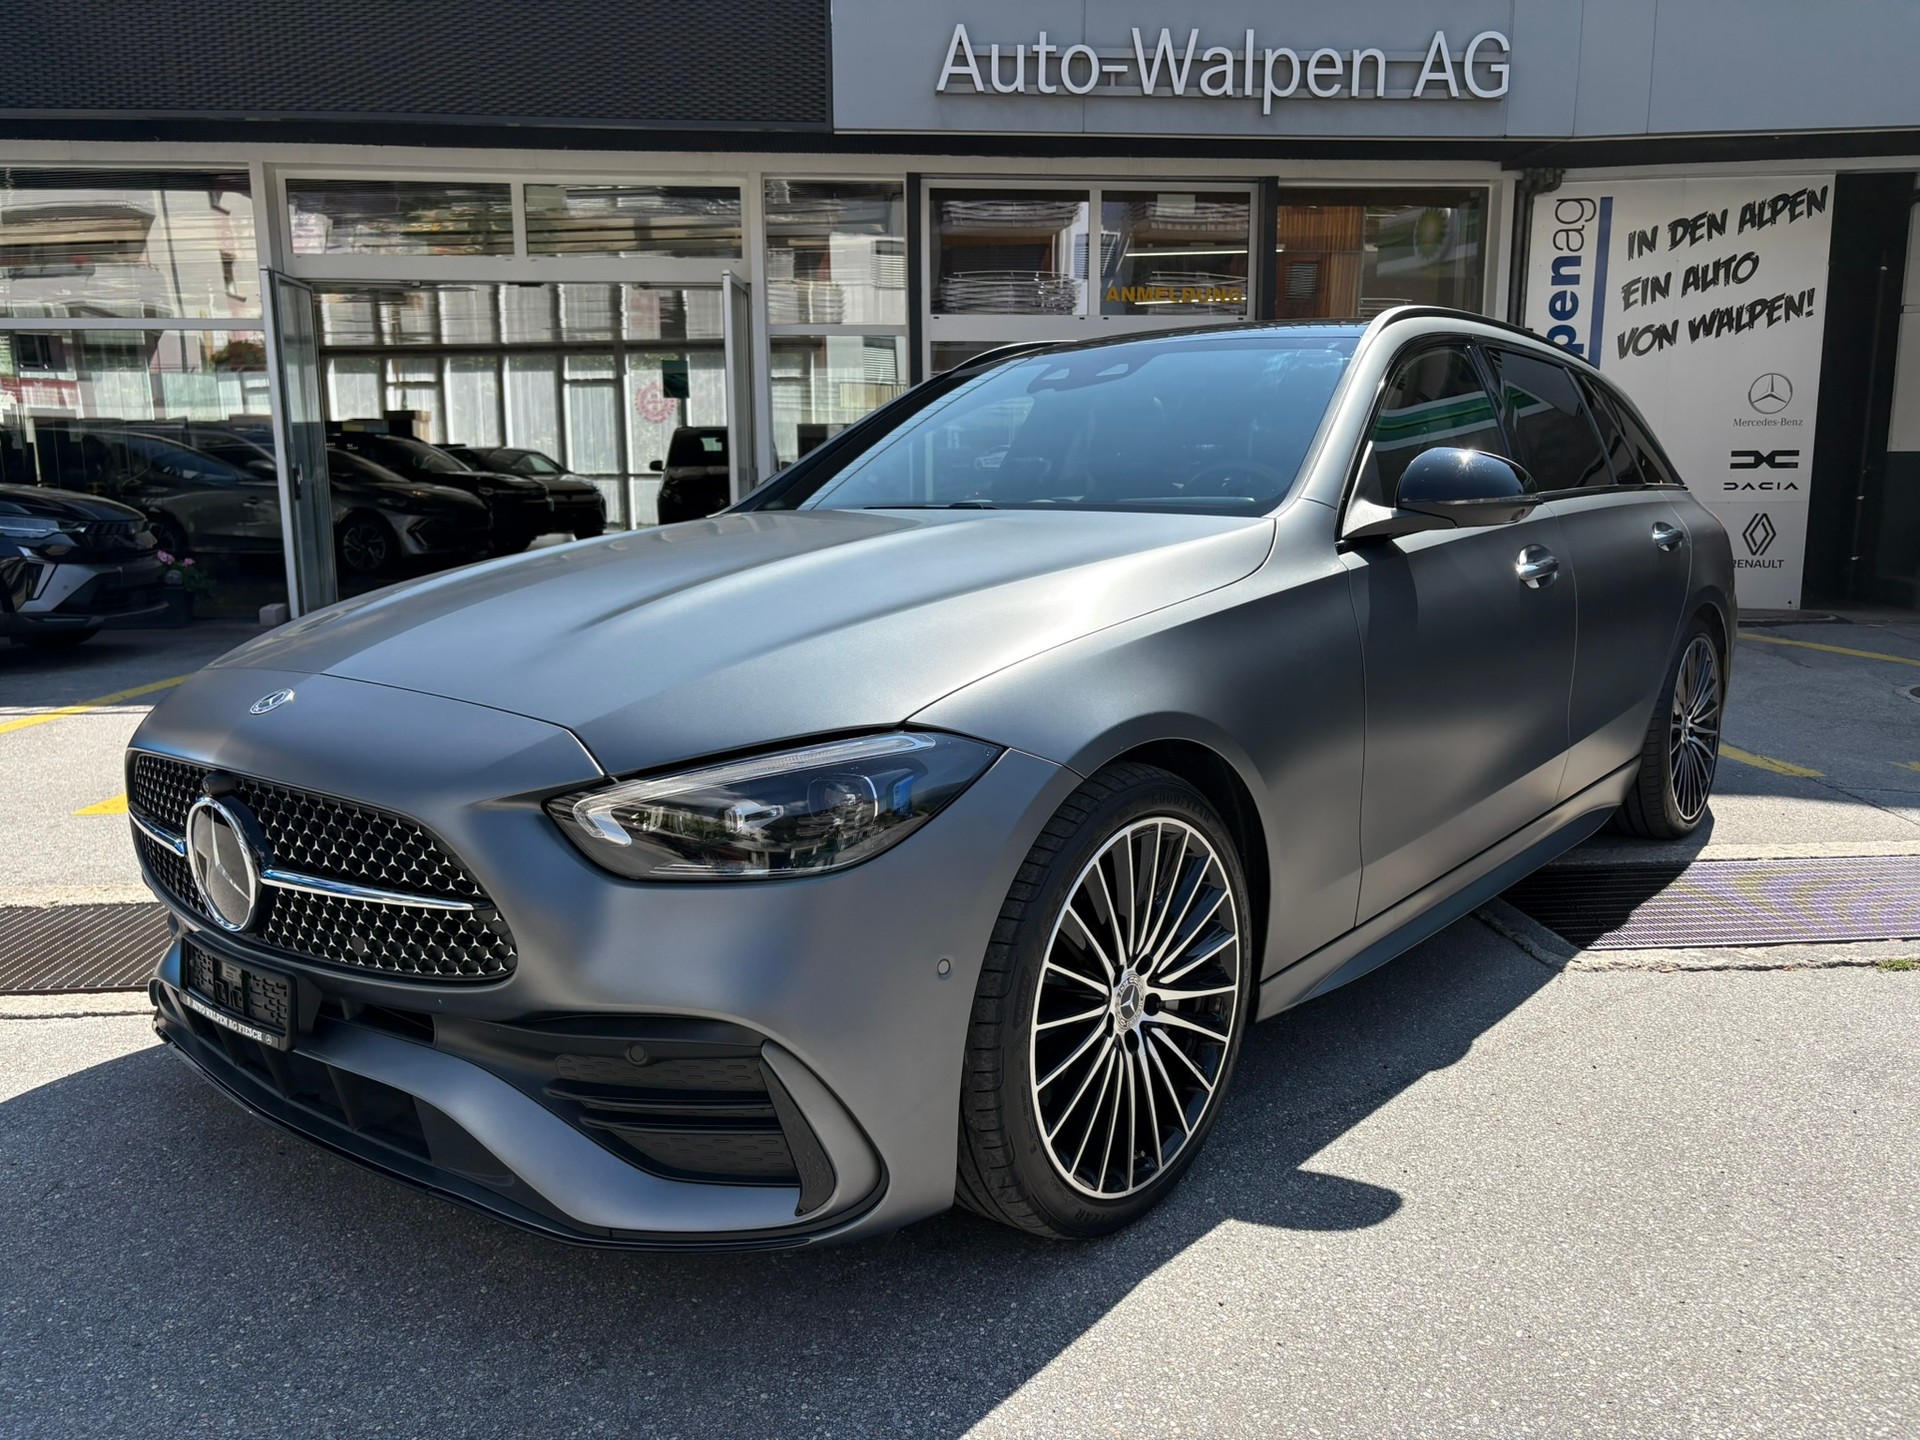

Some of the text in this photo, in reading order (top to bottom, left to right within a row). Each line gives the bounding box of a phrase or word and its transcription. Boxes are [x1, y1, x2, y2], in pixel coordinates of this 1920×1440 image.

[936, 24, 1510, 115] Auto-Walpen AG
[1627, 185, 1829, 260] IN DEN ALPEN
[1106, 286, 1243, 304] ANMELDUNG
[1621, 251, 1760, 312] EIN AUTO
[1617, 288, 1816, 360] VON WALPEN!
[1732, 417, 1804, 428] Mercedes-Benz
[1723, 481, 1799, 491] DACIA
